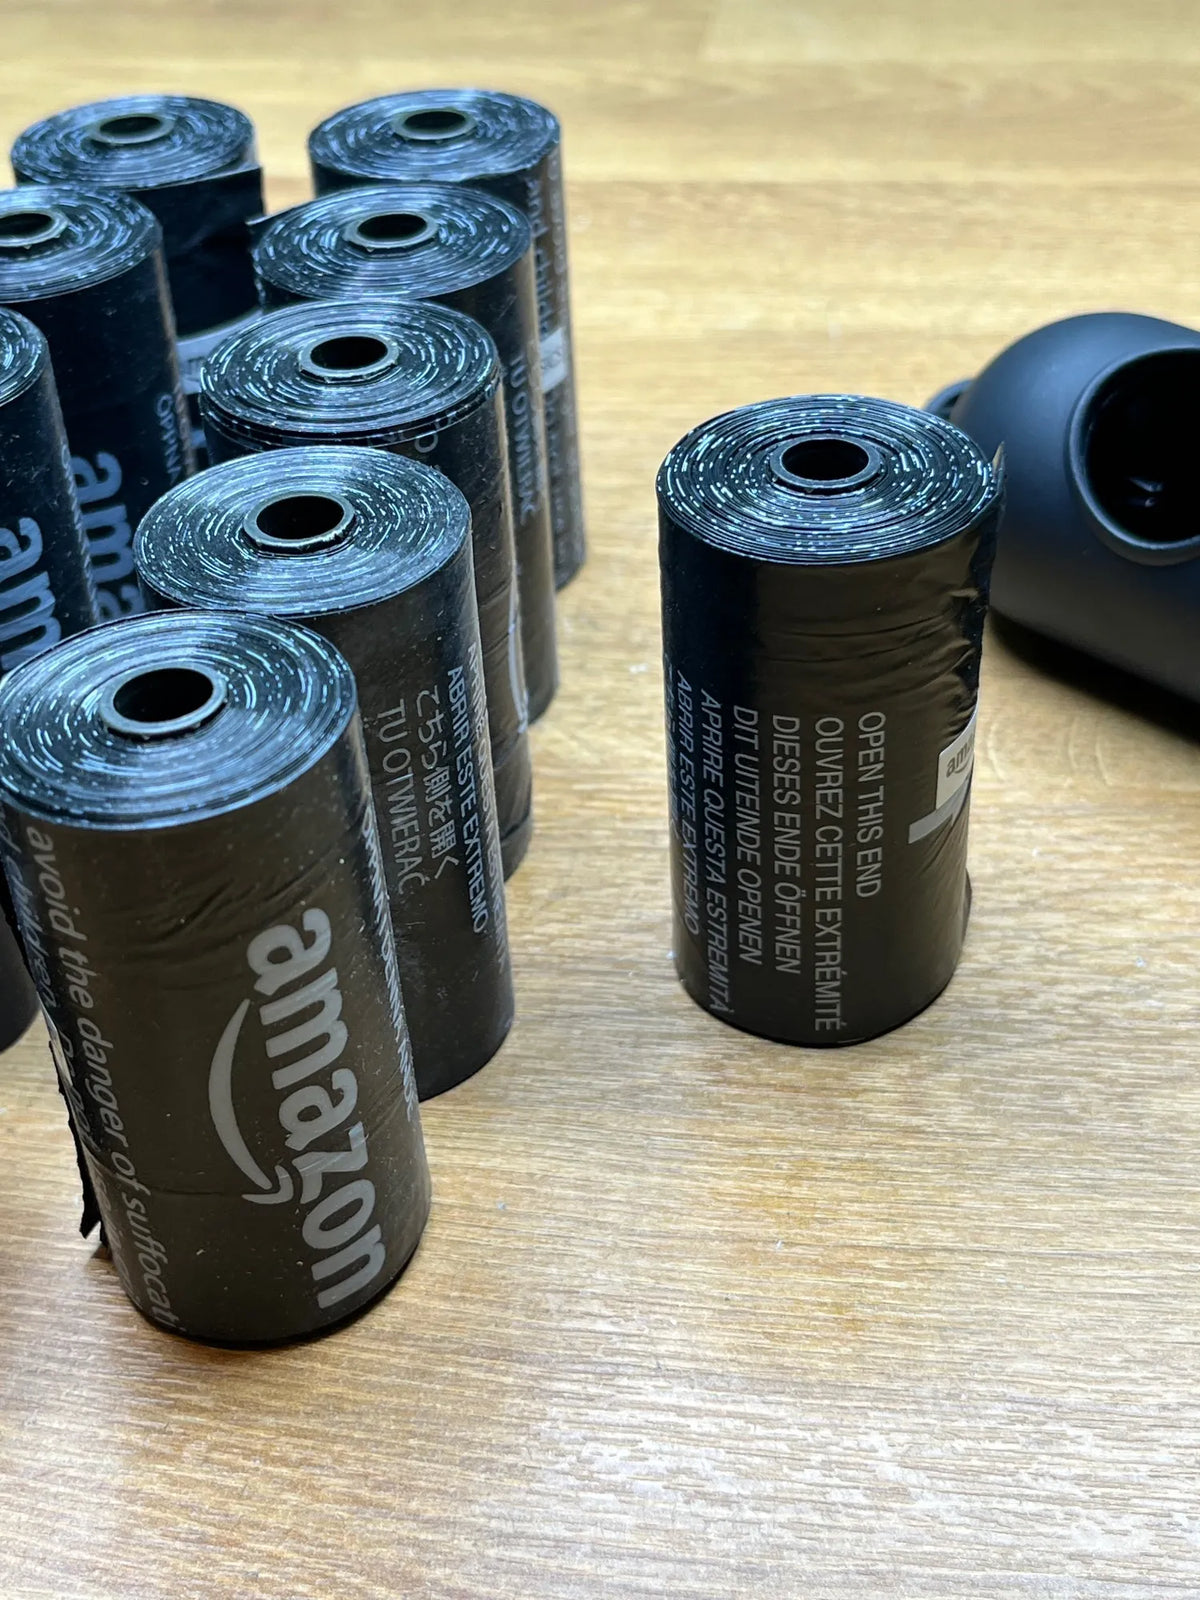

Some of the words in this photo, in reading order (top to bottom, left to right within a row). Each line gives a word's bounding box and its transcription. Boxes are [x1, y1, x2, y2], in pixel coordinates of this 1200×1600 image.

[376, 698, 408, 744] TU
[447, 664, 473, 749] ABRIR
[677, 668, 695, 753] ABRIR
[700, 687, 724, 788] APRIRE
[733, 704, 760, 750] DIT
[857, 711, 887, 783] OPEN
[415, 684, 460, 880] こちら側を開く
[456, 745, 479, 816] ESTE
[679, 750, 697, 823] ESTE
[772, 714, 801, 806] DIESES
[814, 716, 845, 820] OUVREZ
[382, 747, 431, 896] OTWIERAĆ
[703, 787, 727, 885] QUESTA
[734, 752, 762, 867] UITEINDE
[773, 811, 801, 878] ENDE
[856, 785, 884, 844] THIS
[26, 825, 88, 942] avoid
[462, 814, 489, 934] EXTREMO
[681, 820, 700, 937] EXTREMO
[815, 825, 844, 902] CETTE
[855, 847, 882, 898] END
[6, 855, 58, 1009] children
[706, 886, 735, 1014] ESTREMITÀ
[736, 867, 763, 965] OPENEN
[774, 881, 807, 975] ÖFFNEN
[58, 946, 98, 1010] the
[814, 907, 848, 1031] EXTRÉMITÉ
[77, 1016, 129, 1149] danger
[245, 907, 387, 1310] amazon
[111, 1151, 151, 1196] of
